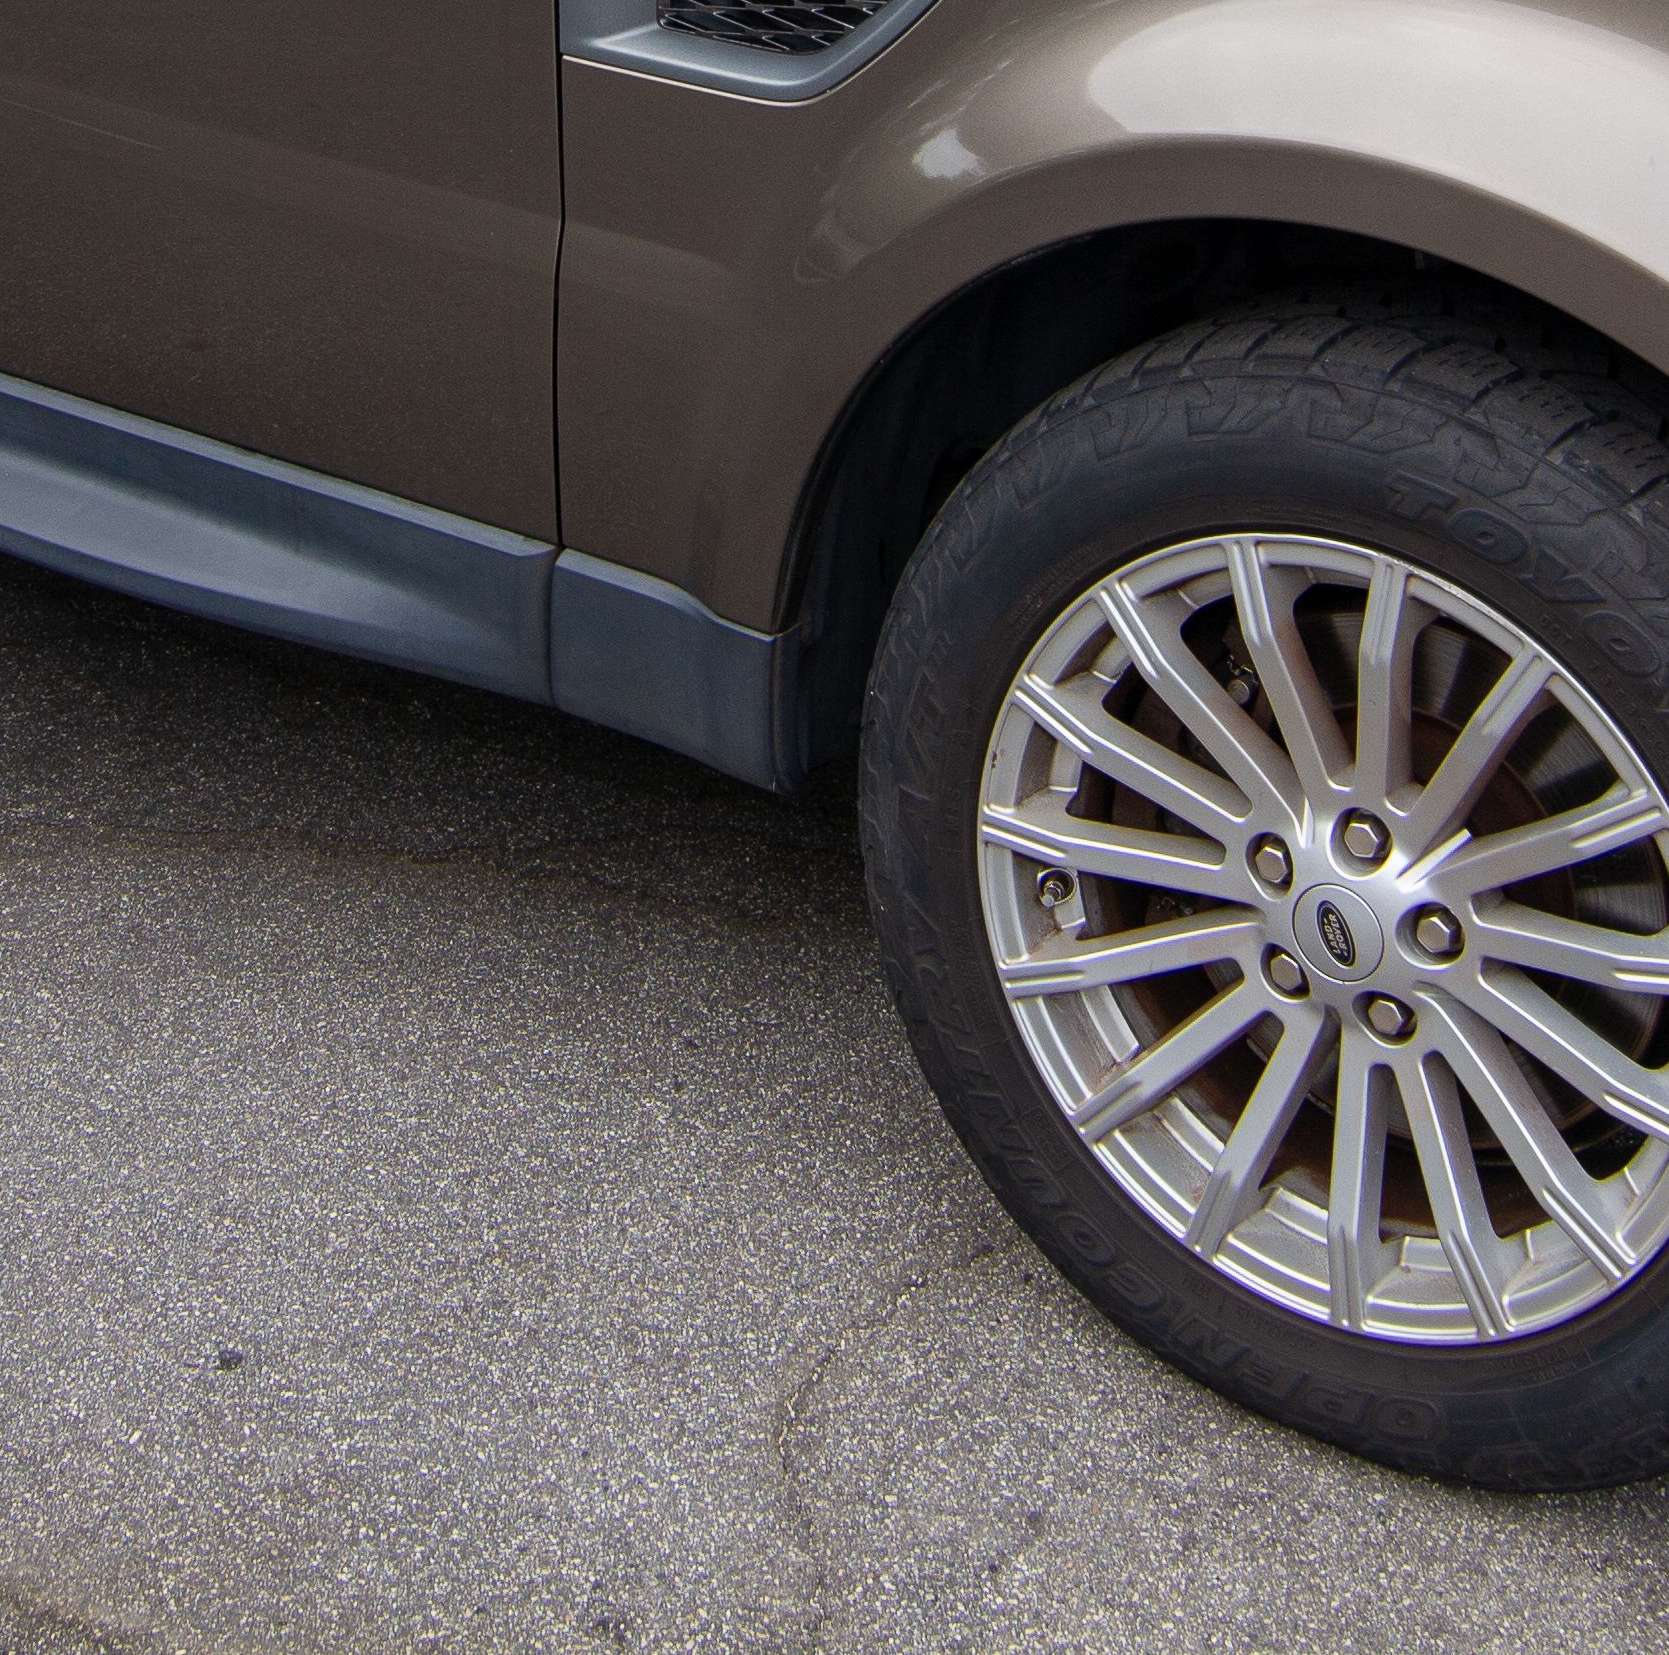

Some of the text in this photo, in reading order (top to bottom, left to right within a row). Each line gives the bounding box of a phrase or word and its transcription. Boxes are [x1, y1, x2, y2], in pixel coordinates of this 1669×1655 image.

[1386, 471, 1662, 677] TOYO
[1328, 913, 1348, 950] ROVER
[901, 890, 1166, 1313] COUNTRY
[1170, 1317, 1443, 1441] OPEN
